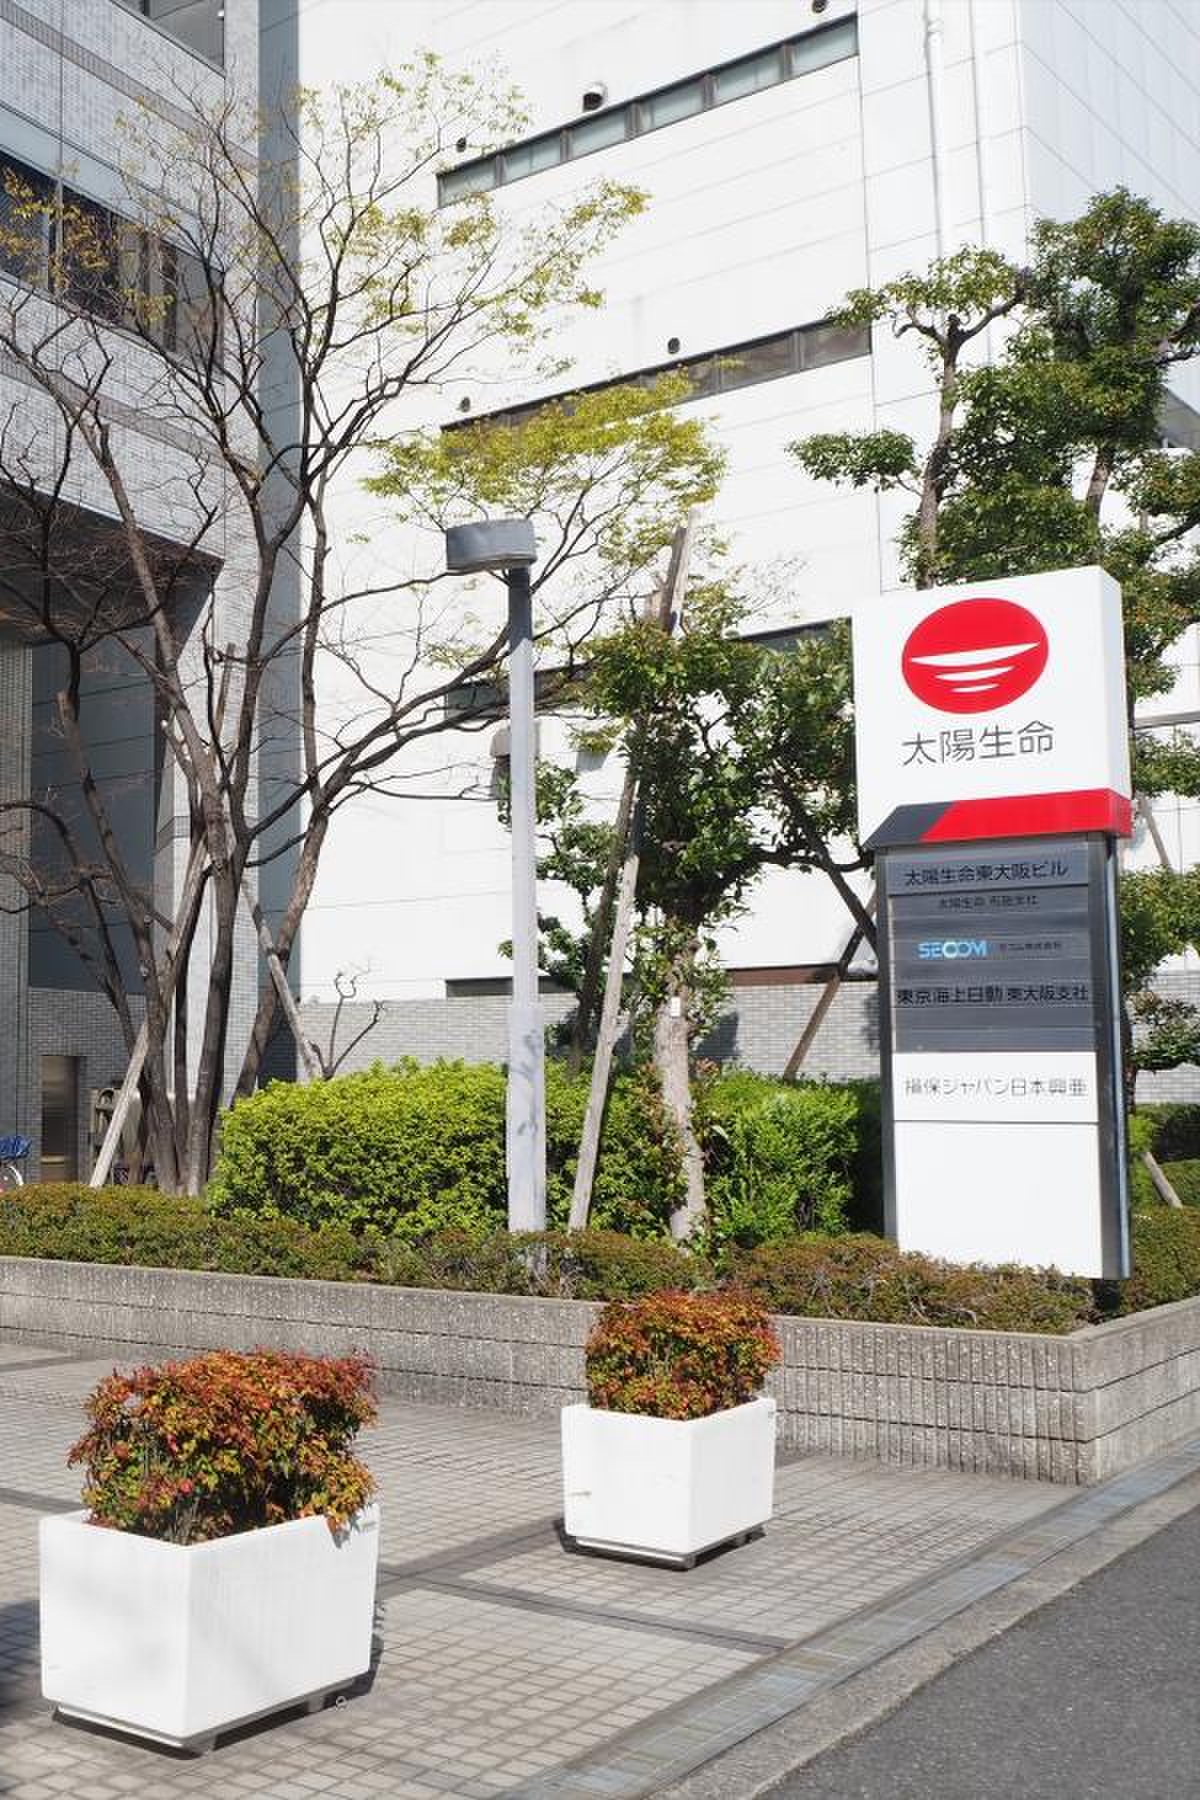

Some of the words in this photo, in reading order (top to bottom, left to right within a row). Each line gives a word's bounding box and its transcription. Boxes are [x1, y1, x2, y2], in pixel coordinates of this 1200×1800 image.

[902, 720, 1055, 766] 太陽生命
[905, 860, 1068, 886] 太陽生命東大阪ビル
[918, 940, 988, 958] SECOM
[897, 985, 1003, 1004] 東京海上日動
[1007, 984, 1090, 1002] 東大阪支社
[905, 1078, 1087, 1097] 損保ジャパン日本興亜
